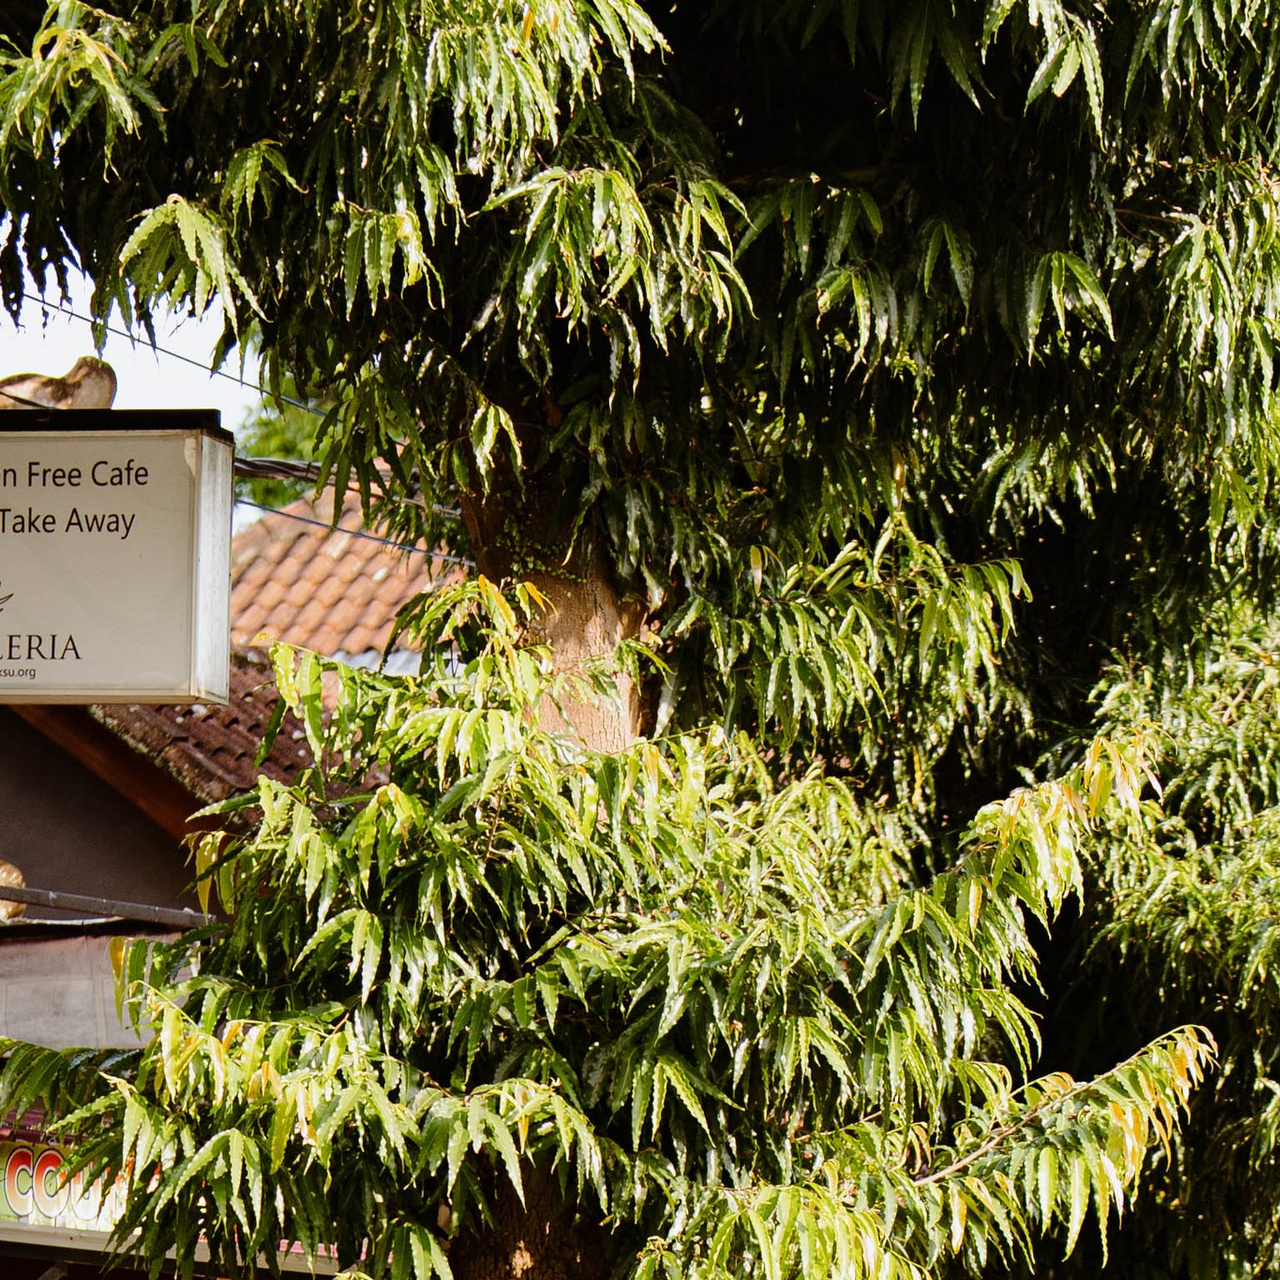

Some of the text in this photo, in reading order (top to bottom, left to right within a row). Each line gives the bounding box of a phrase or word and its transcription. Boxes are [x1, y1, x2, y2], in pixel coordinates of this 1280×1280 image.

[28, 461, 82, 487] Free
[91, 459, 149, 487] Cafe
[0, 507, 136, 540] Take Away
